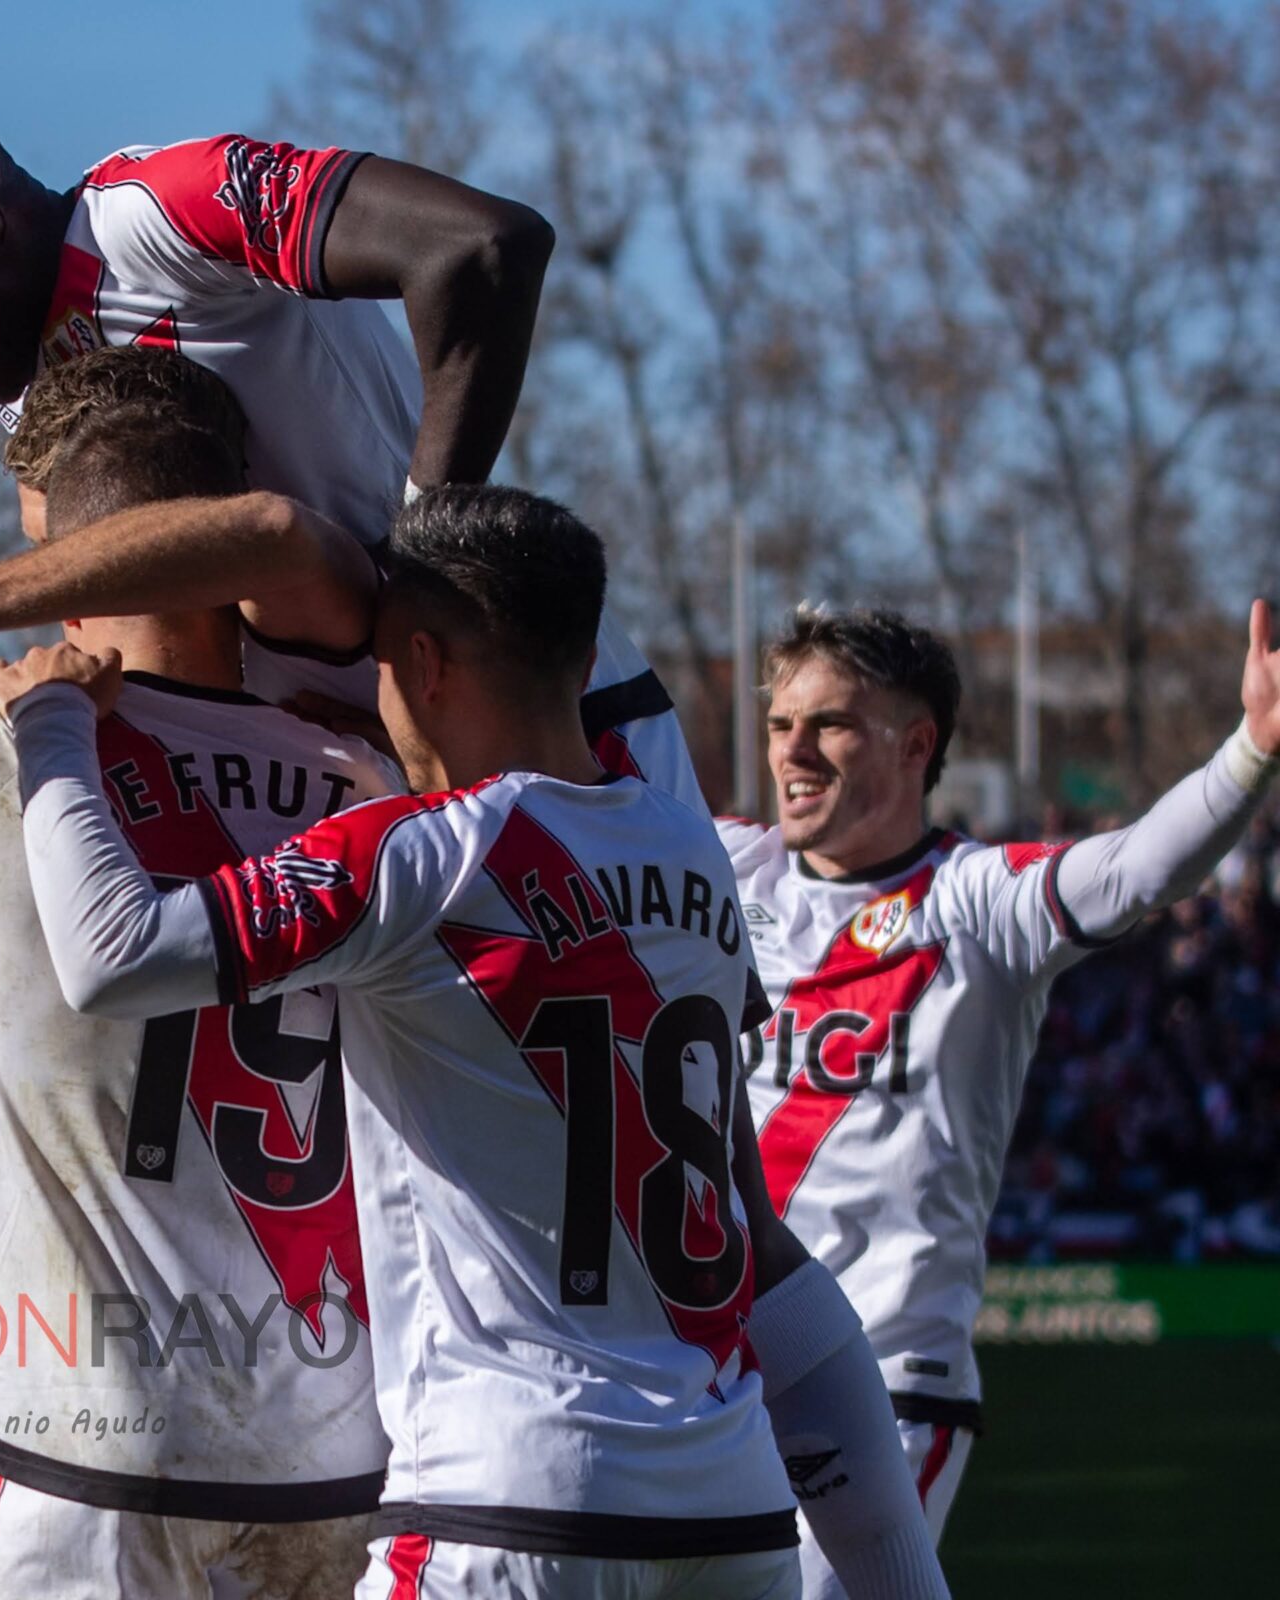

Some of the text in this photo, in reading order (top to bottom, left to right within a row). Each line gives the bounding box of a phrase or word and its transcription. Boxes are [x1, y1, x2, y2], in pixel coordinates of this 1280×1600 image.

[104, 752, 368, 825] E FRUT
[522, 864, 742, 963] ÁLVARO
[519, 995, 749, 1312] 18
